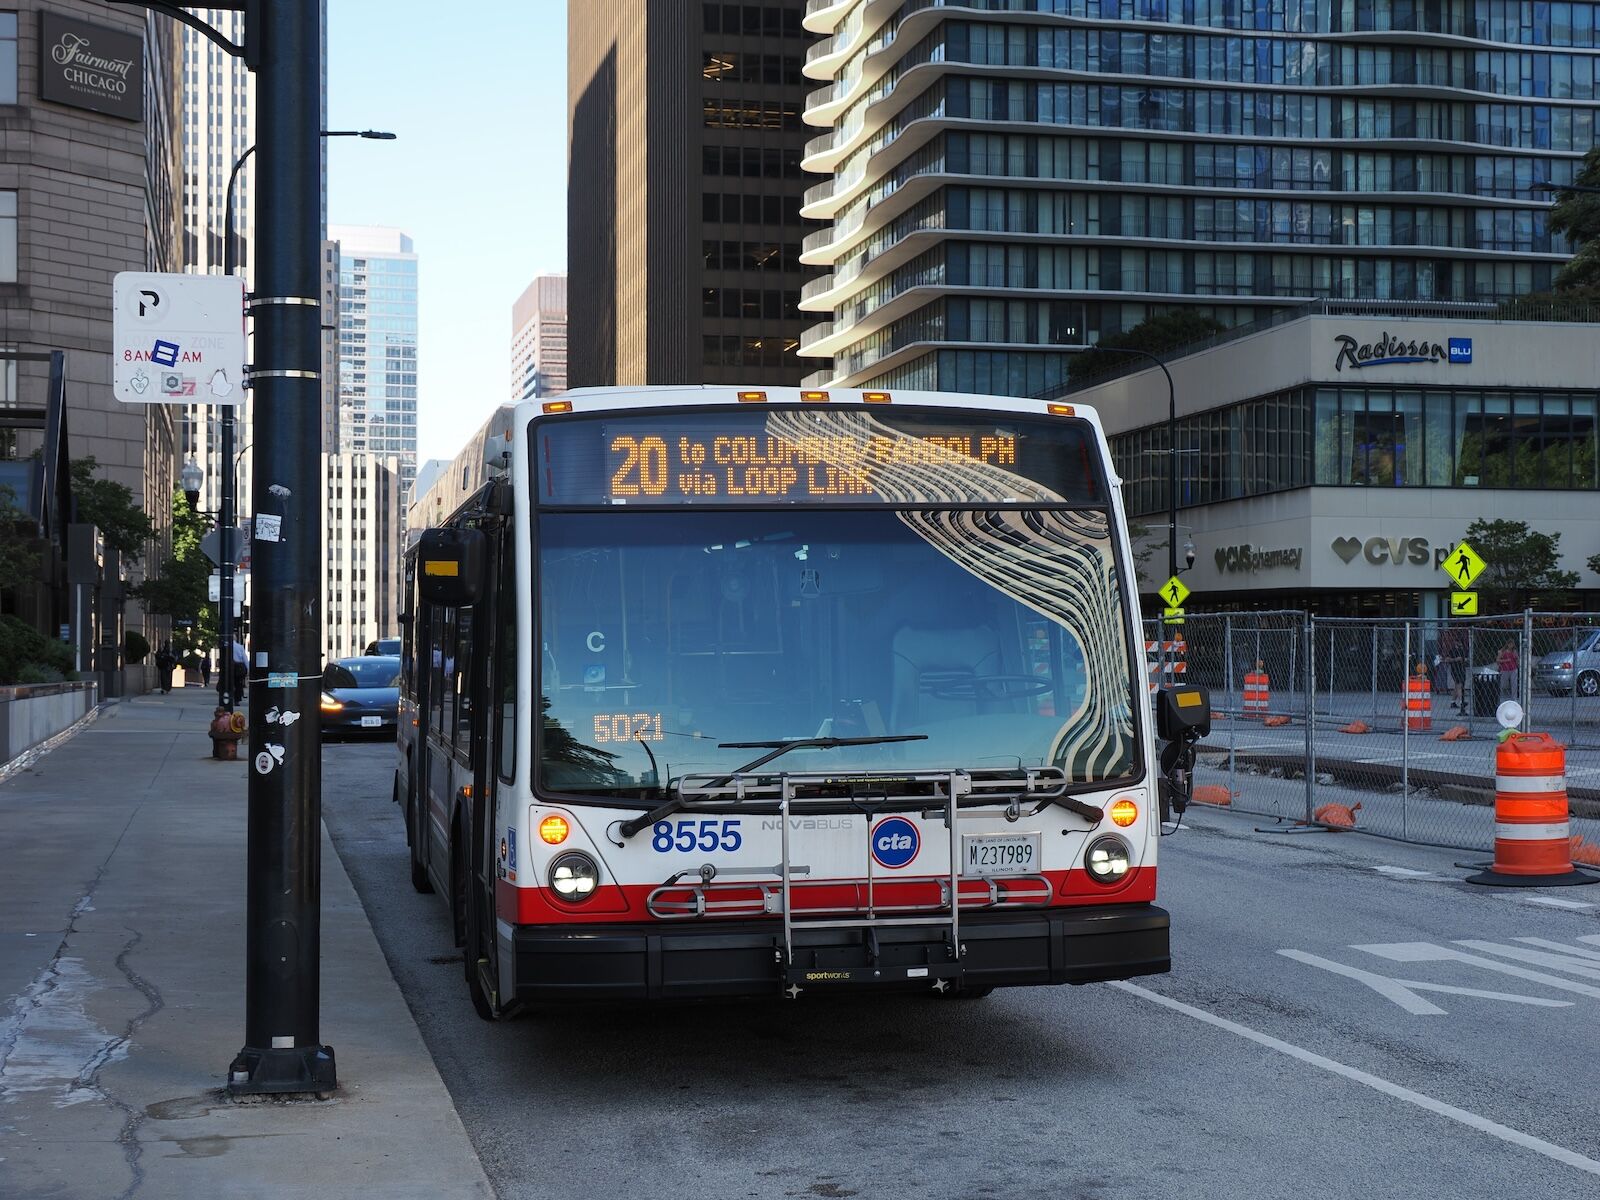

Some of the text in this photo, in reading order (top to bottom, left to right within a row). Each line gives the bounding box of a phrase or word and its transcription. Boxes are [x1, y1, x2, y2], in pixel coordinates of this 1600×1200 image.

[52, 32, 135, 80] Fairmont
[63, 67, 127, 94] CHICAGO
[191, 337, 225, 350] ZONE
[1334, 331, 1471, 372] Radisson BLU
[611, 436, 668, 495] 20
[679, 436, 705, 464] to
[679, 467, 873, 495] via LOOP LINK
[1226, 544, 1303, 576] CVS pharmacy
[1363, 536, 1430, 566] CVS
[586, 631, 606, 653] C
[594, 713, 664, 742] 5021
[652, 819, 743, 854] 8555
[877, 833, 913, 851] cta
